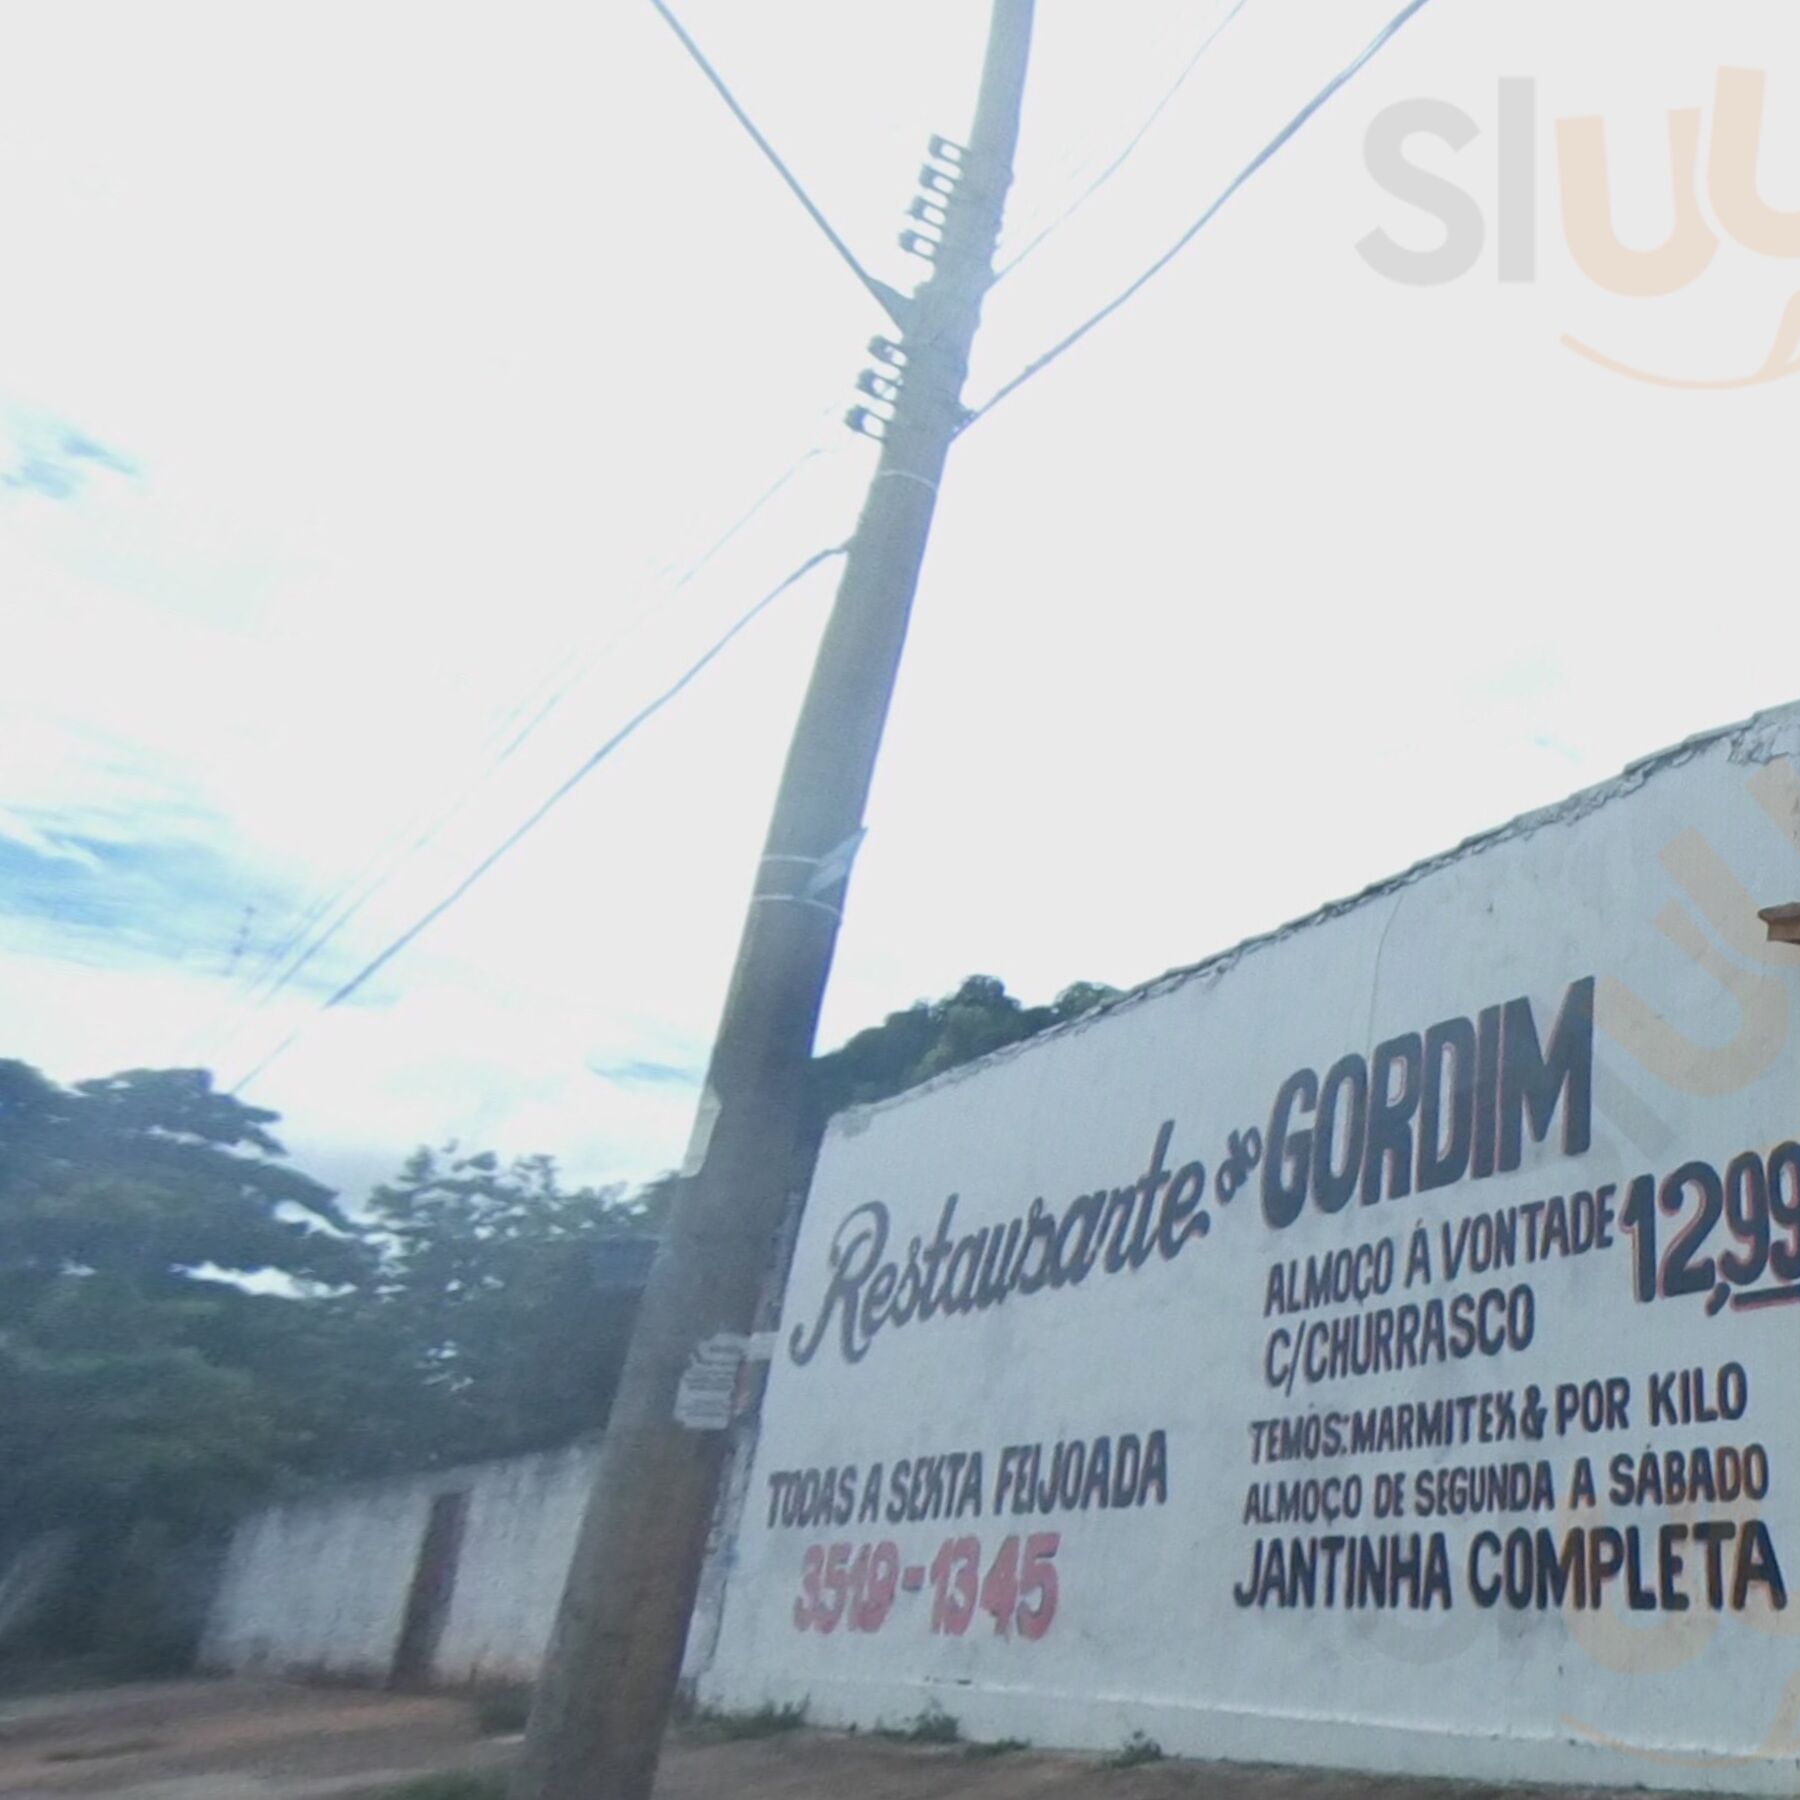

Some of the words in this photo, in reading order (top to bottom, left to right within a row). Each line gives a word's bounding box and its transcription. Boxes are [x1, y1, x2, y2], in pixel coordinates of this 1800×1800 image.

[1260, 976, 1595, 1229] GORDIM
[1264, 1238, 1394, 1318] ALMOÇO
[1441, 1183, 1617, 1281] VONTADE
[1264, 1284, 1535, 1397] C/CHURRASCO
[1521, 1385, 1548, 1440] &
[1556, 1376, 1630, 1436] POR
[1649, 1362, 1748, 1428] KILO
[766, 1465, 851, 1529] TODAS
[857, 1463, 883, 1524] A
[993, 1429, 1169, 1516] FEIJOADA
[1244, 1474, 1363, 1527] ALMOÇO
[1373, 1470, 1405, 1519] DE
[1414, 1459, 1555, 1518] SEGUNDA
[1569, 1455, 1596, 1509] A
[1609, 1443, 1770, 1506] SÁBADO
[1234, 1531, 1453, 1611] JANTINHA
[1468, 1519, 1788, 1611] COMPLETA
